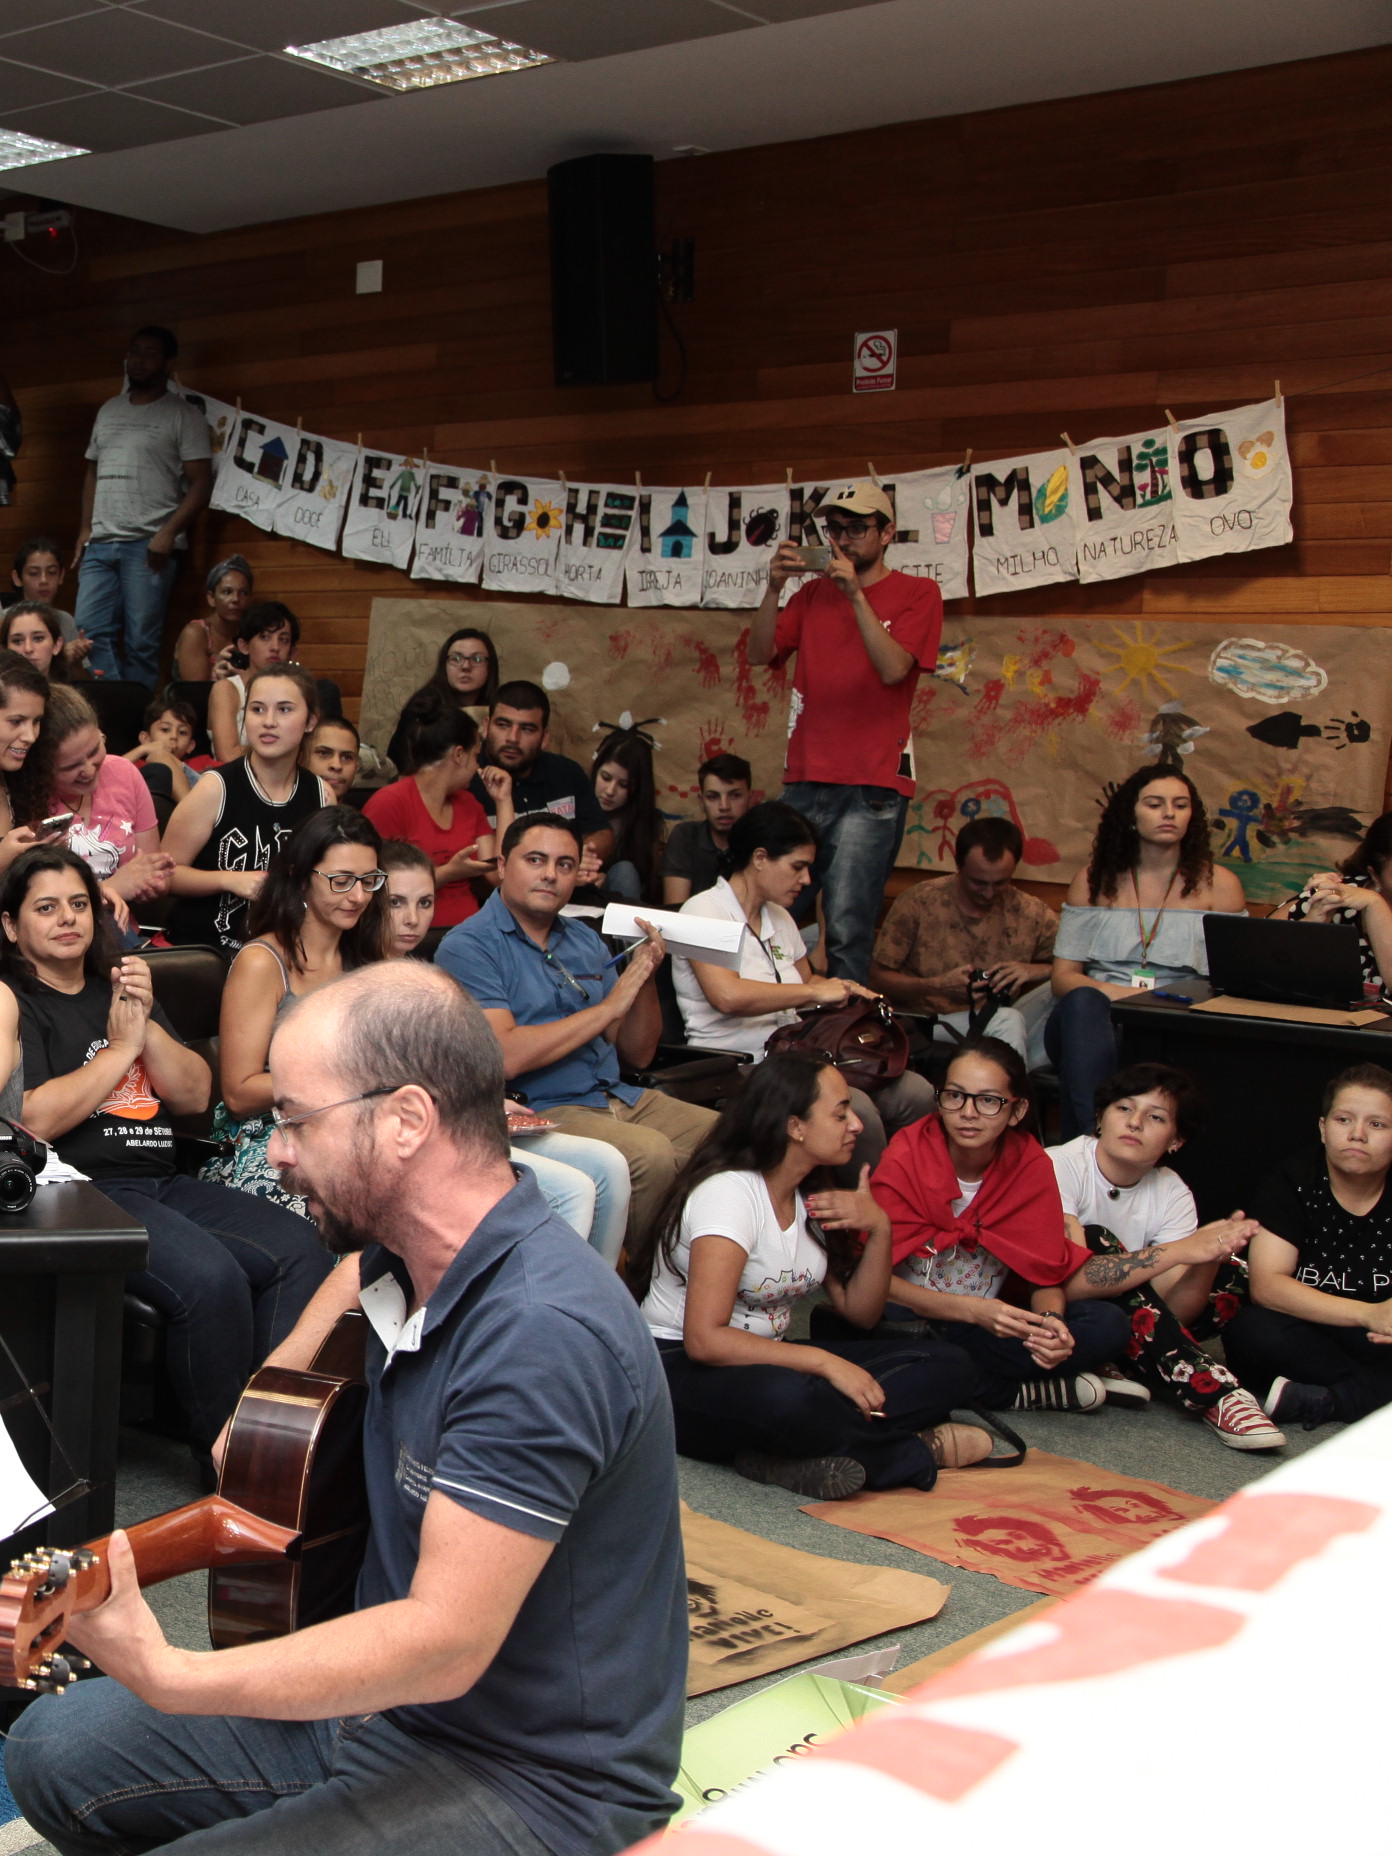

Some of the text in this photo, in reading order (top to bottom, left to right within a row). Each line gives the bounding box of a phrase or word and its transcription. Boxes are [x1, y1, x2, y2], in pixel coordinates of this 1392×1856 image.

[291, 437, 324, 494] D
[1176, 426, 1236, 502] O
[234, 485, 260, 506] CASA
[359, 455, 392, 511] E
[1078, 445, 1138, 522] N
[425, 473, 461, 530] F
[493, 480, 530, 541] G
[973, 465, 1035, 538] M
[294, 506, 324, 530] DOCE
[565, 487, 601, 548] H
[707, 491, 742, 556] J
[1209, 508, 1254, 538] OVO
[418, 541, 474, 568] FAMÍLIA
[1083, 524, 1179, 562] NATUREZA
[488, 551, 552, 579] GIRASSOL
[564, 564, 603, 583] HORTA
[996, 546, 1059, 576] MILHO
[637, 569, 683, 592] IGREJA
[704, 568, 770, 590] JOANINH
[118, 1126, 128, 1135] 28
[134, 1126, 144, 1135] 29
[144, 1126, 153, 1136] de
[126, 1139, 158, 1148] ABELARDO
